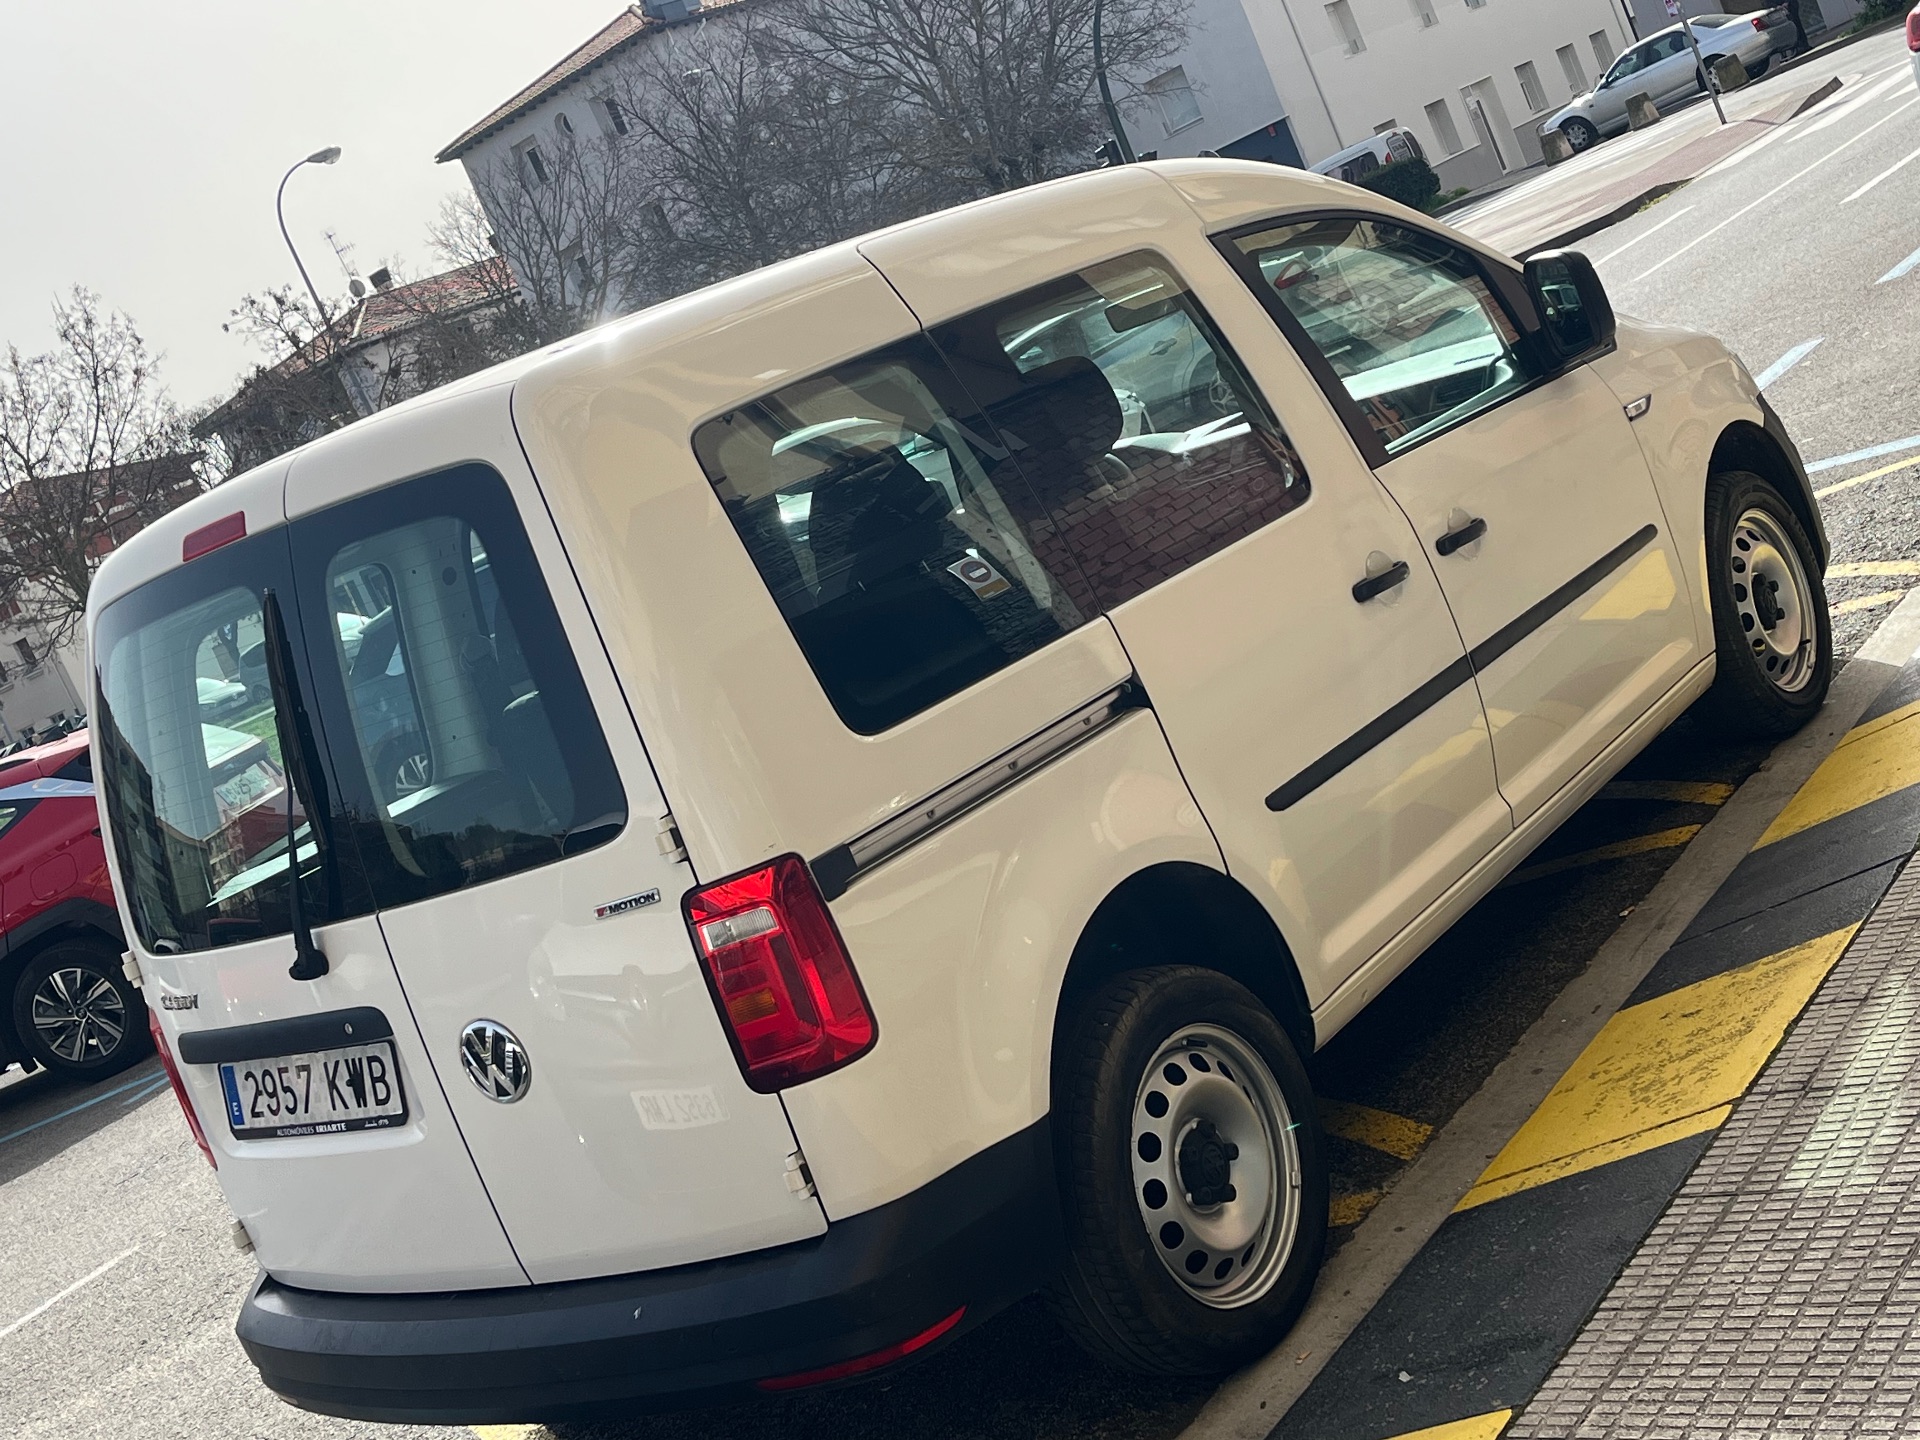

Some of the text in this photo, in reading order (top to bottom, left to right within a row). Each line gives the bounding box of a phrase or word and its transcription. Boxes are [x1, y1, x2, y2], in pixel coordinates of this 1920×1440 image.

[243, 1054, 392, 1118] 2957 KWB
[232, 1102, 239, 1116] E
[315, 1122, 347, 1133] IRIARTE
